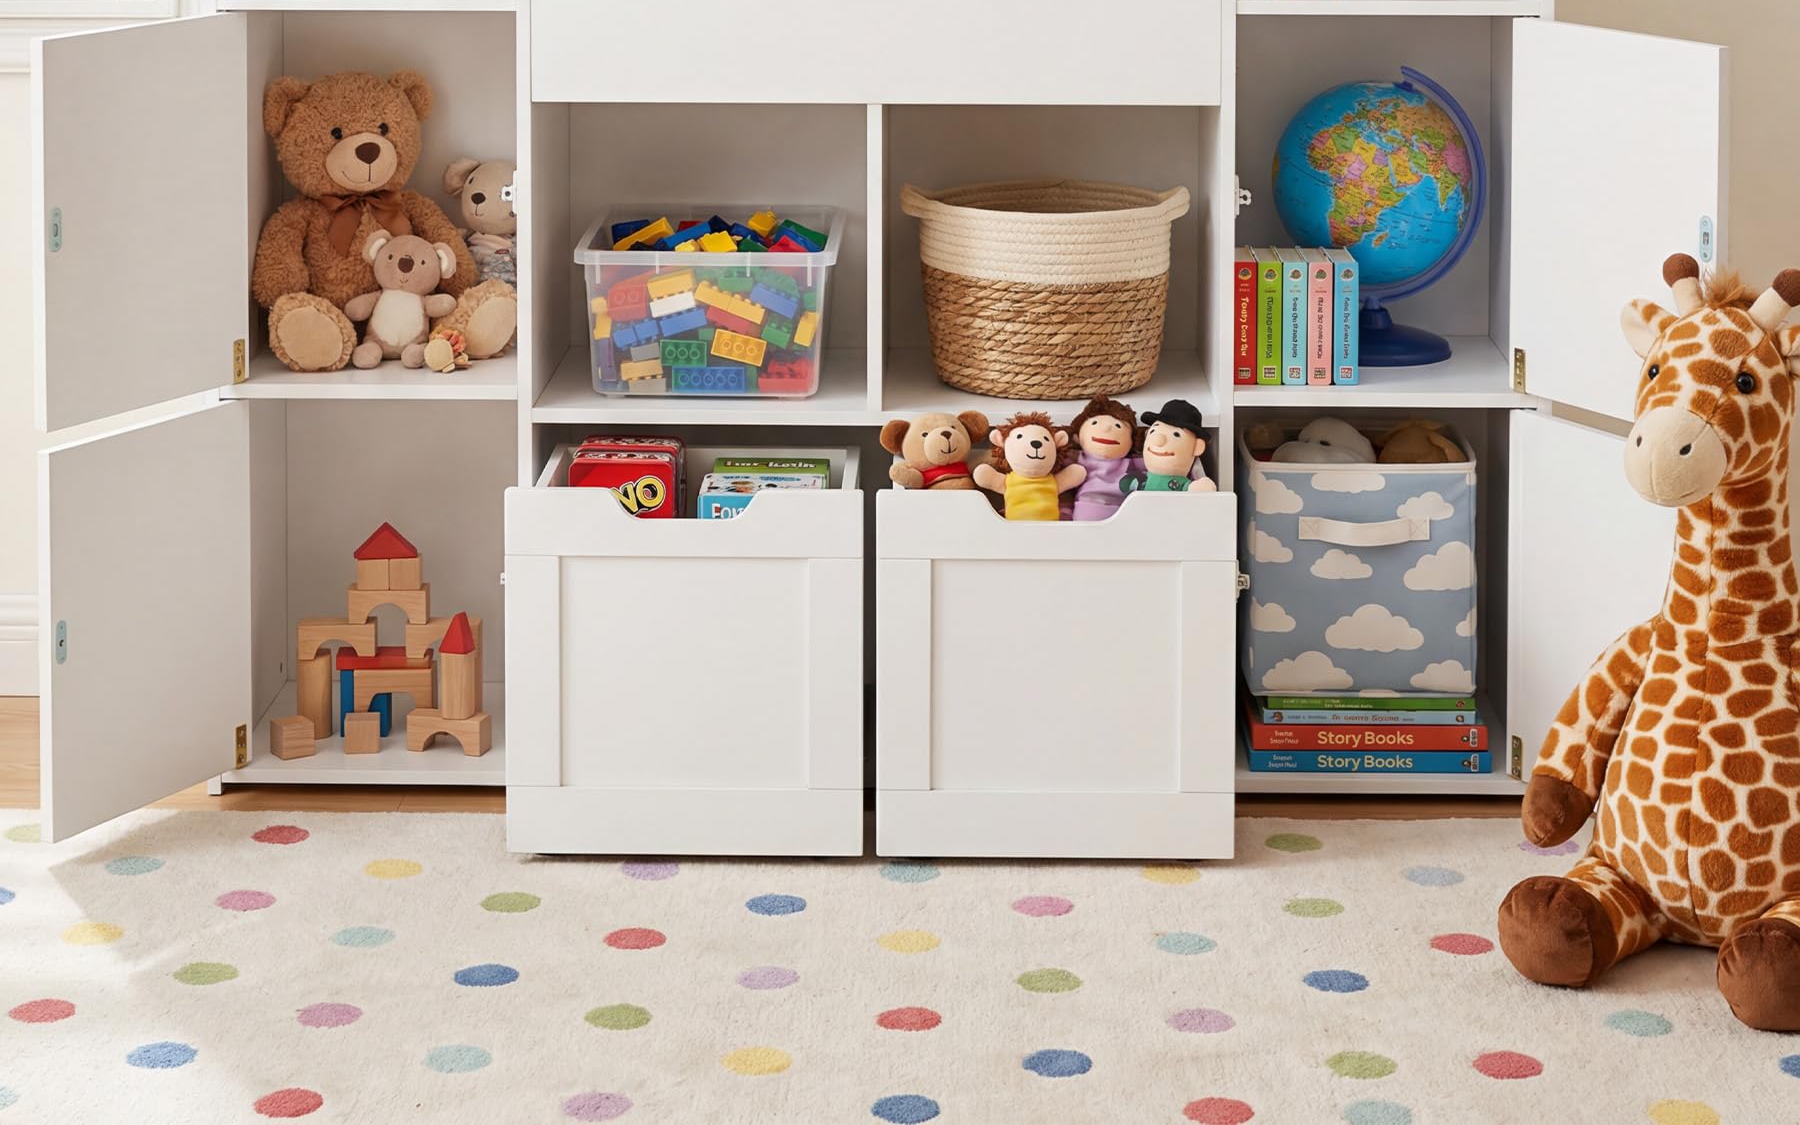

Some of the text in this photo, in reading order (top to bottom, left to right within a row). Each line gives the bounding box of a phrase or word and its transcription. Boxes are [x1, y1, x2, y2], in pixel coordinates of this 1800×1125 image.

[1317, 731, 1361, 748] Story
[1364, 731, 1414, 745] Books
[1317, 755, 1414, 772] Story Books
